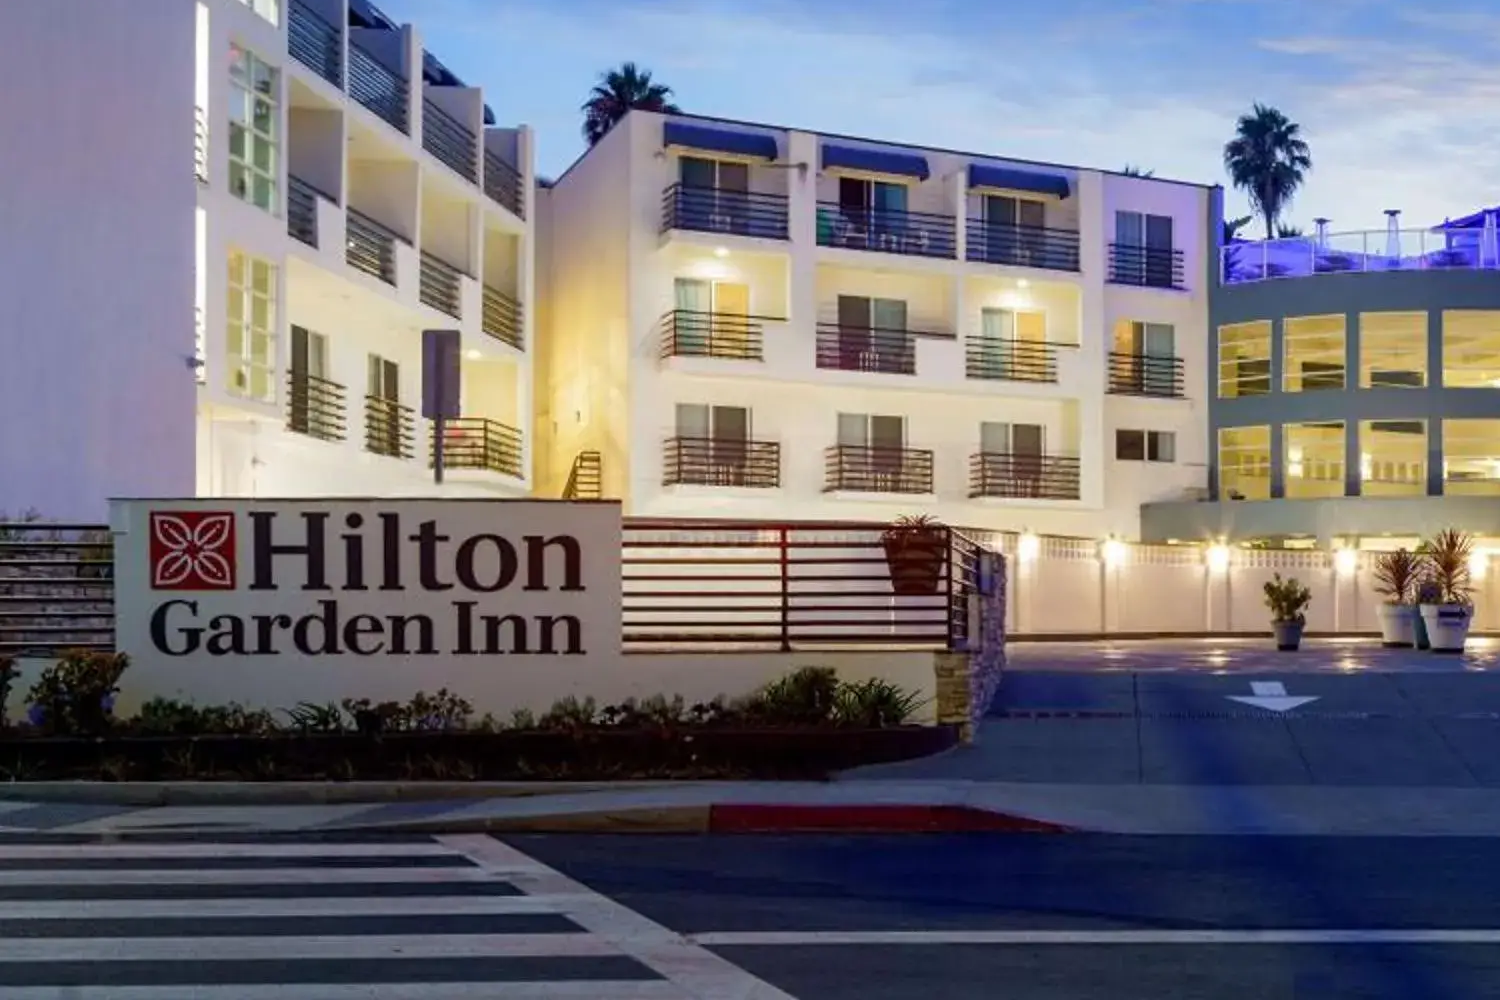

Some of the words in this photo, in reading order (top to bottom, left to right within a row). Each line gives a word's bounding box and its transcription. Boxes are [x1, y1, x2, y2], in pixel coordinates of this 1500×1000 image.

[247, 511, 586, 592] Hilton
[149, 599, 440, 657] Garden
[451, 600, 587, 656] Inn
